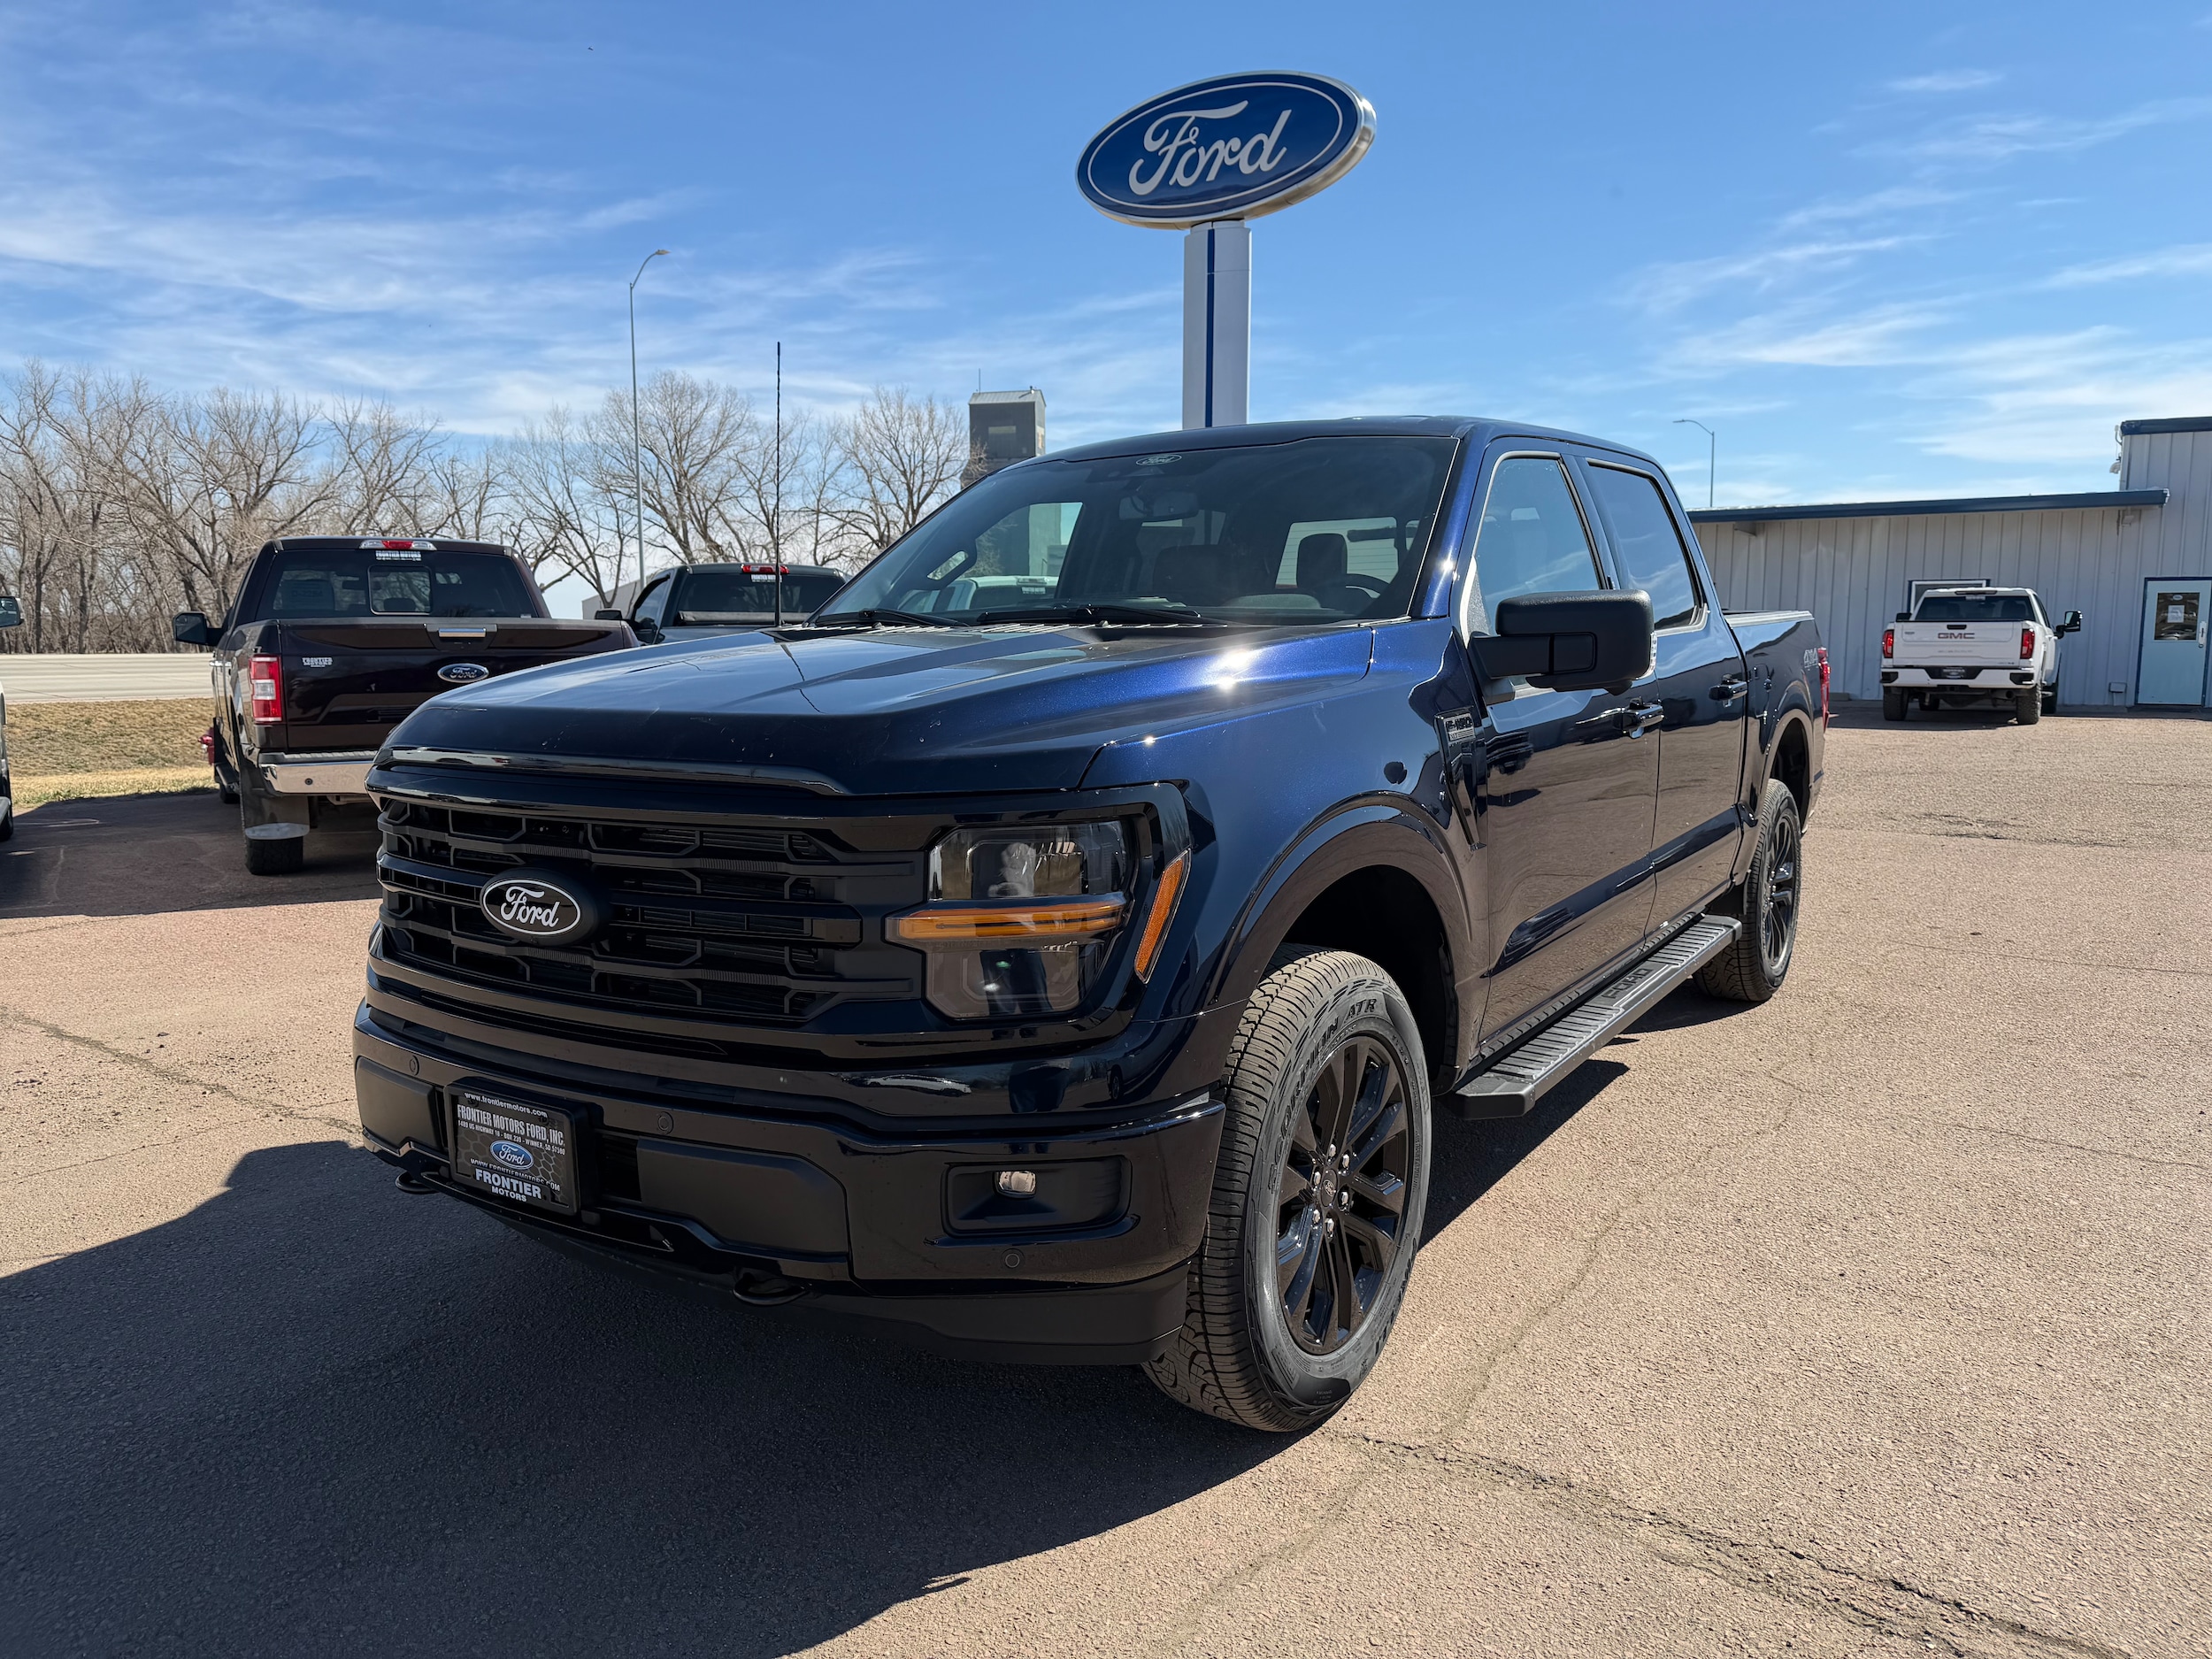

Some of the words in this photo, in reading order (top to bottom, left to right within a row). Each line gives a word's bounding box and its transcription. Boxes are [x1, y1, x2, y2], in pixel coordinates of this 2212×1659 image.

[1128, 100, 1292, 196] Ford
[449, 667, 477, 679] Ford
[501, 886, 560, 927] Ford
[1601, 968, 1653, 999] FORD
[1344, 998, 1377, 1020] ATR
[465, 1092, 548, 1118] www.frontiermotors.com
[457, 1104, 492, 1125] FRONTIER
[493, 1115, 525, 1135] MOTORS
[526, 1123, 549, 1142] FORD,
[549, 1128, 565, 1147] INC.
[475, 1125, 494, 1134] HIGHWAY
[498, 1144, 525, 1165] Ford
[475, 1168, 541, 1199] FRONTIER
[491, 1186, 527, 1202] MOTORS
